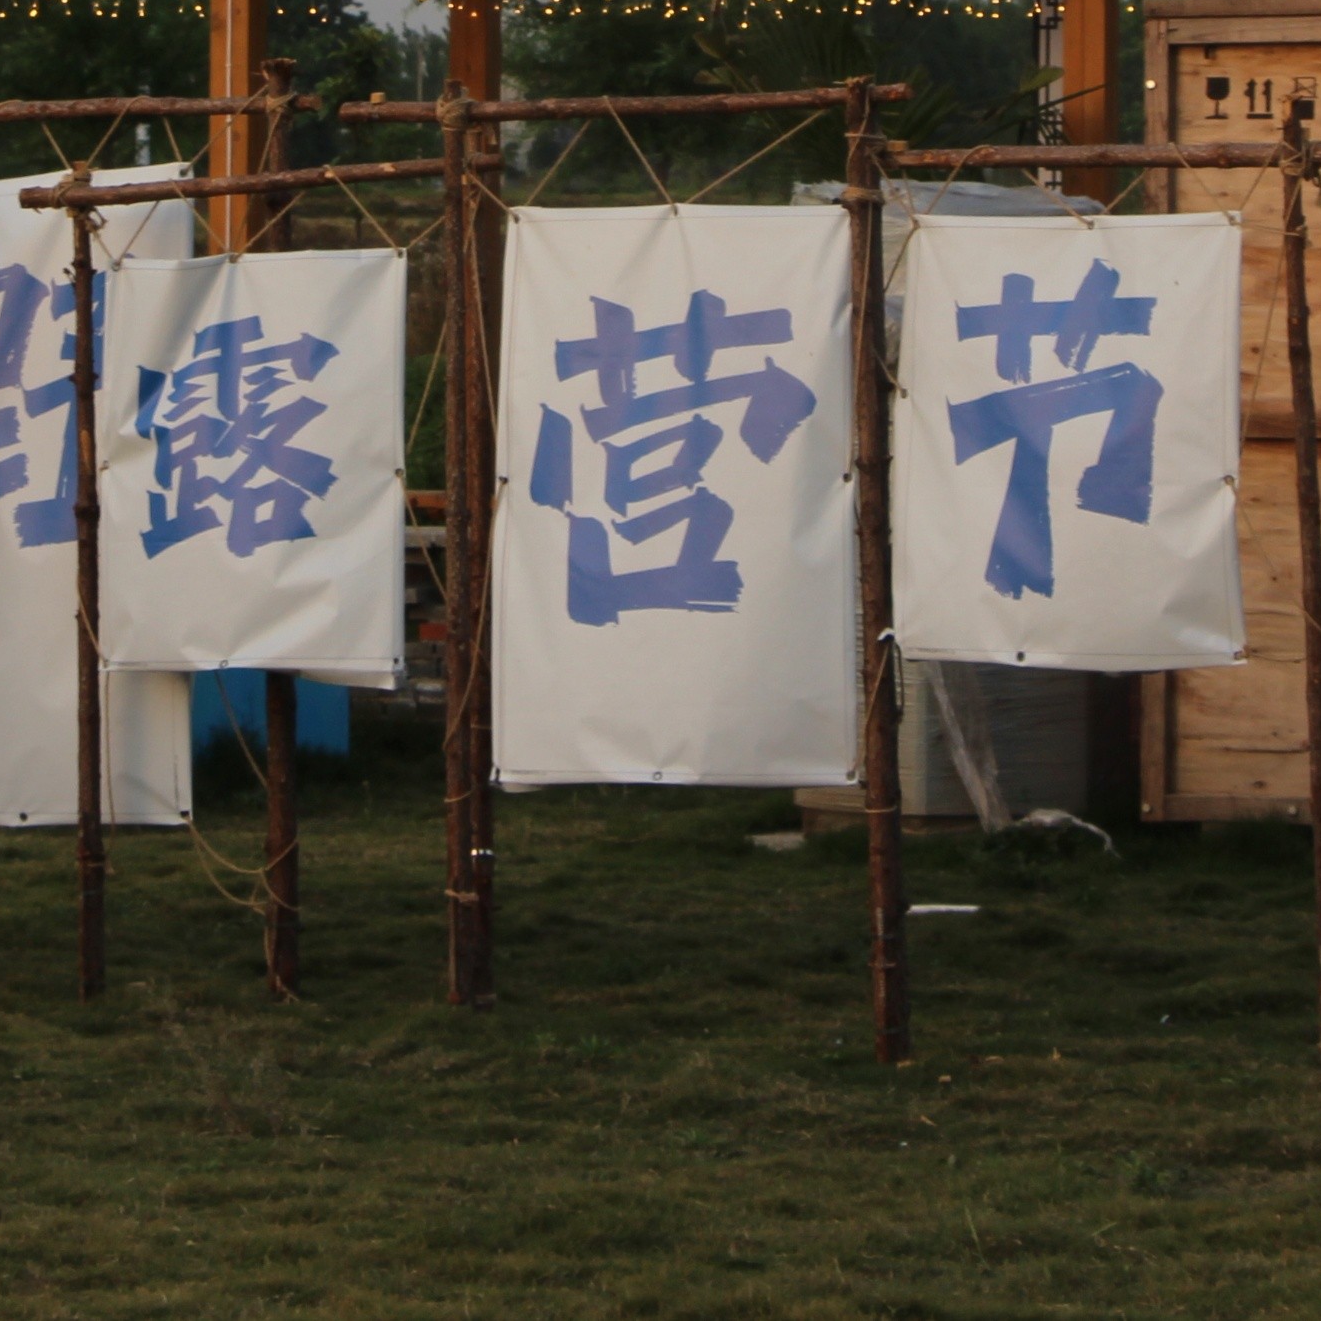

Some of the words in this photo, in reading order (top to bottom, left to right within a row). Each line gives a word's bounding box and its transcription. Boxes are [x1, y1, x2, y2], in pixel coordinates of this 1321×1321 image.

[137, 316, 339, 558] 露
[530, 289, 816, 625] 营
[948, 258, 1162, 599] 节
